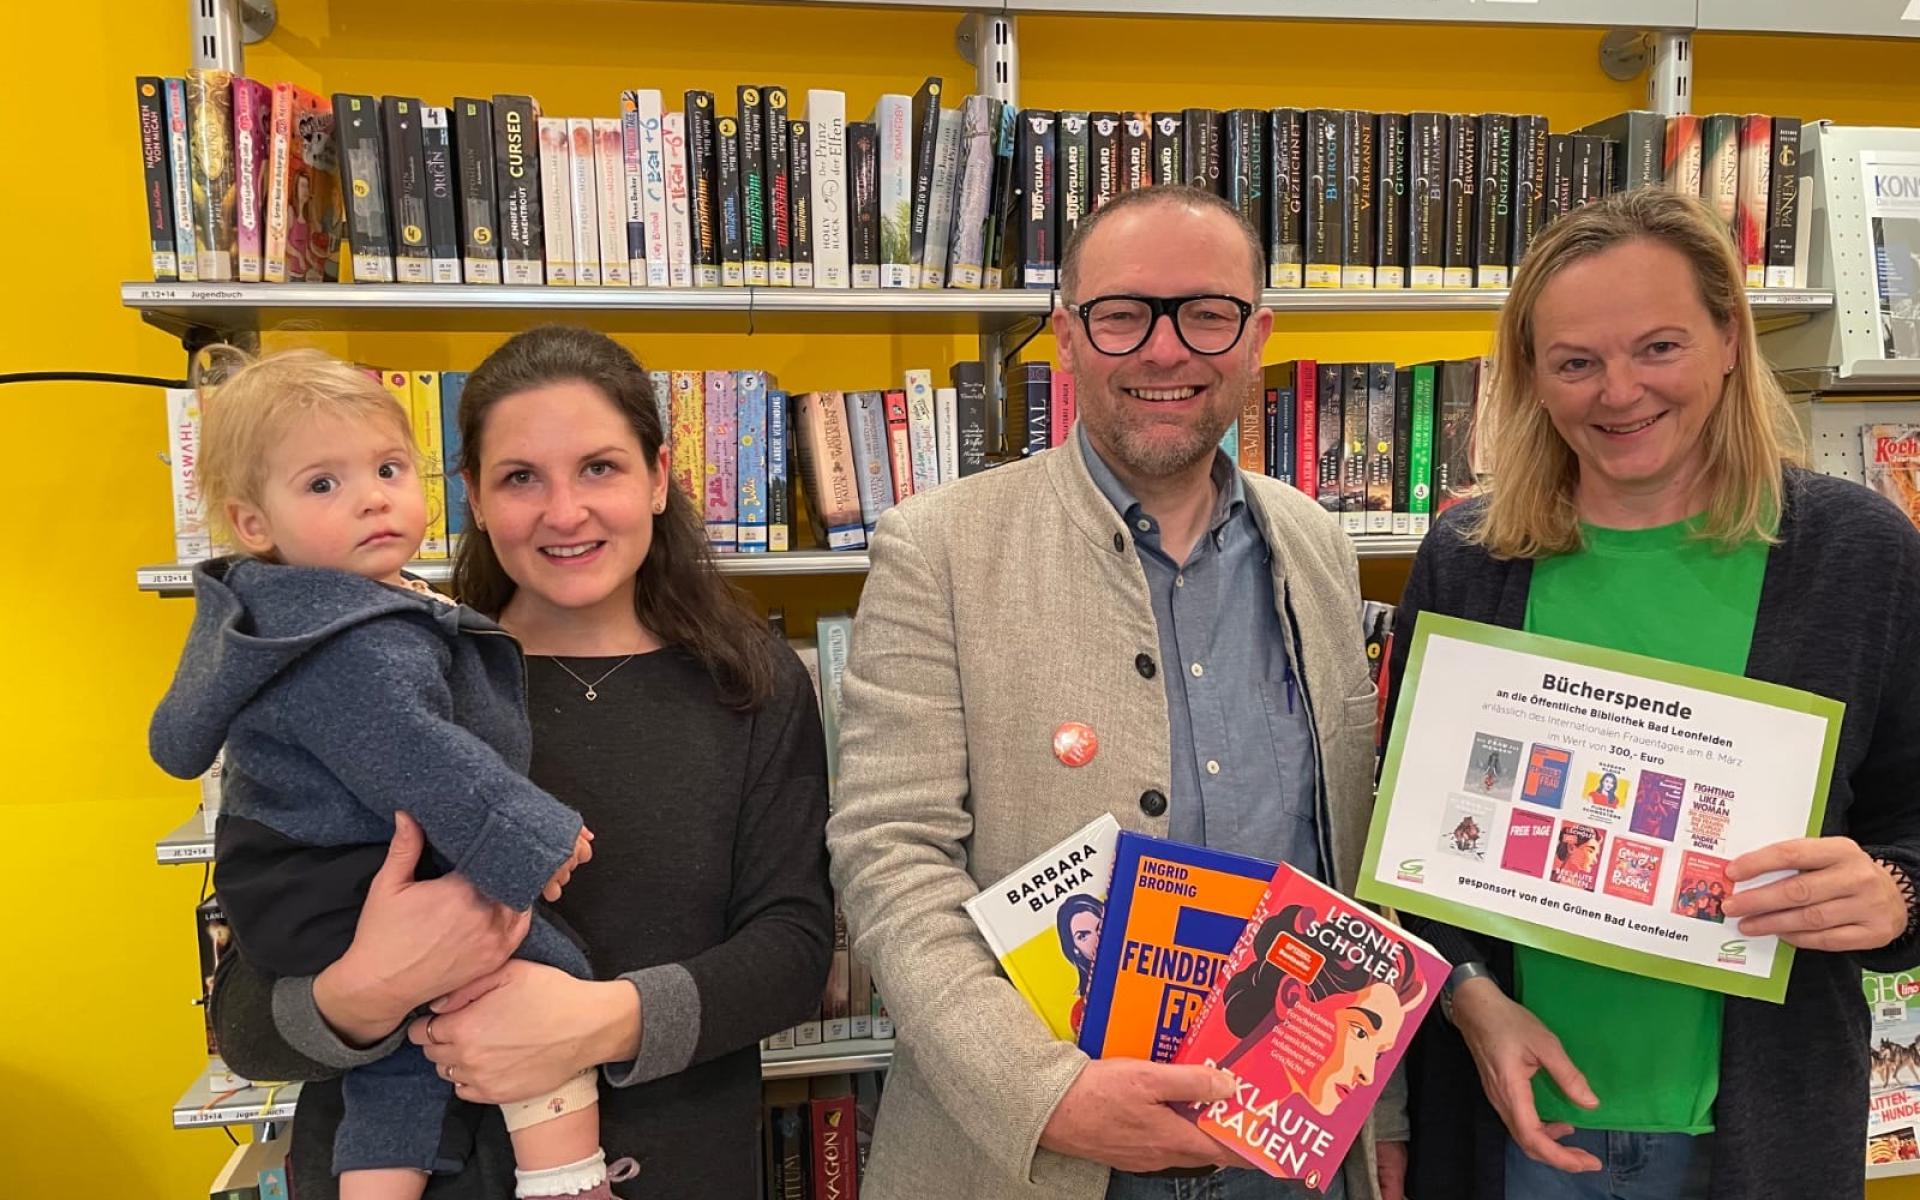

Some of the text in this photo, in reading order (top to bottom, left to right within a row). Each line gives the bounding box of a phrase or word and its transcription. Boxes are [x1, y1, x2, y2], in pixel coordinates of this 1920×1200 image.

[142, 105, 154, 168] NACHRICHTEN
[151, 111, 162, 162] VON MICAH
[428, 109, 437, 124] 4
[815, 122, 827, 157] Prinz
[894, 103, 904, 161] SOMMERBY
[507, 111, 523, 177] CURSED
[828, 118, 842, 176] der Elfen
[1131, 147, 1140, 189] GUARD
[1250, 124, 1261, 199] VERSUCHT
[1290, 123, 1301, 213] GEZEICHNET
[1361, 125, 1371, 210] VERBRANNT
[1395, 128, 1405, 195] GEWECKT
[1535, 130, 1544, 200] VERLOREN
[1643, 139, 1651, 180] Midnight
[1727, 143, 1737, 196] PANEM
[428, 150, 447, 198] ORIGIN
[1032, 146, 1044, 221] BODYGUARD
[1067, 146, 1078, 221] BODYGUARD
[1497, 128, 1510, 215] UNGEZÄHMT
[1561, 176, 1569, 216] TFESSELT
[1875, 175, 1920, 198] KON
[510, 202, 519, 241] JENNIFER
[519, 187, 530, 246] ARMENTROUT
[1781, 174, 1796, 228] PANEM
[191, 291, 243, 299] Jugendbuch
[180, 420, 196, 502] AUSWAHL
[1496, 689, 1733, 748] an die Öffentliche Bibliothek Bad Leonfelden
[1542, 673, 1692, 720] Bücherspende
[1481, 702, 1743, 768] anlässlich des Internationalen Frauentages am 8. März
[1548, 732, 1665, 766] im Wert von 300,- Euro
[1539, 774, 1559, 788] FRAU
[1694, 783, 1735, 799] FIGHTING
[1699, 794, 1718, 804] LIKE
[1693, 801, 1730, 817] WOMAN
[1006, 844, 1097, 905] BARBARA
[1028, 867, 1094, 913] BLAHA
[1138, 877, 1197, 898] BRODNIG
[1143, 860, 1189, 880] INGRID
[1222, 889, 1272, 974] BEKLAUTE
[1325, 906, 1404, 962] LEONIE
[1458, 876, 1689, 942] gesponsort von den Grünen Bad Leonfelden
[1122, 941, 1226, 988] FEINDBI
[1226, 907, 1269, 981] FRAUEN
[1306, 921, 1401, 987] SCHÖLER
[1163, 989, 1204, 1033] FR
[1204, 1058, 1334, 1157] KLAUTE
[1880, 1102, 1920, 1122] HUNDE
